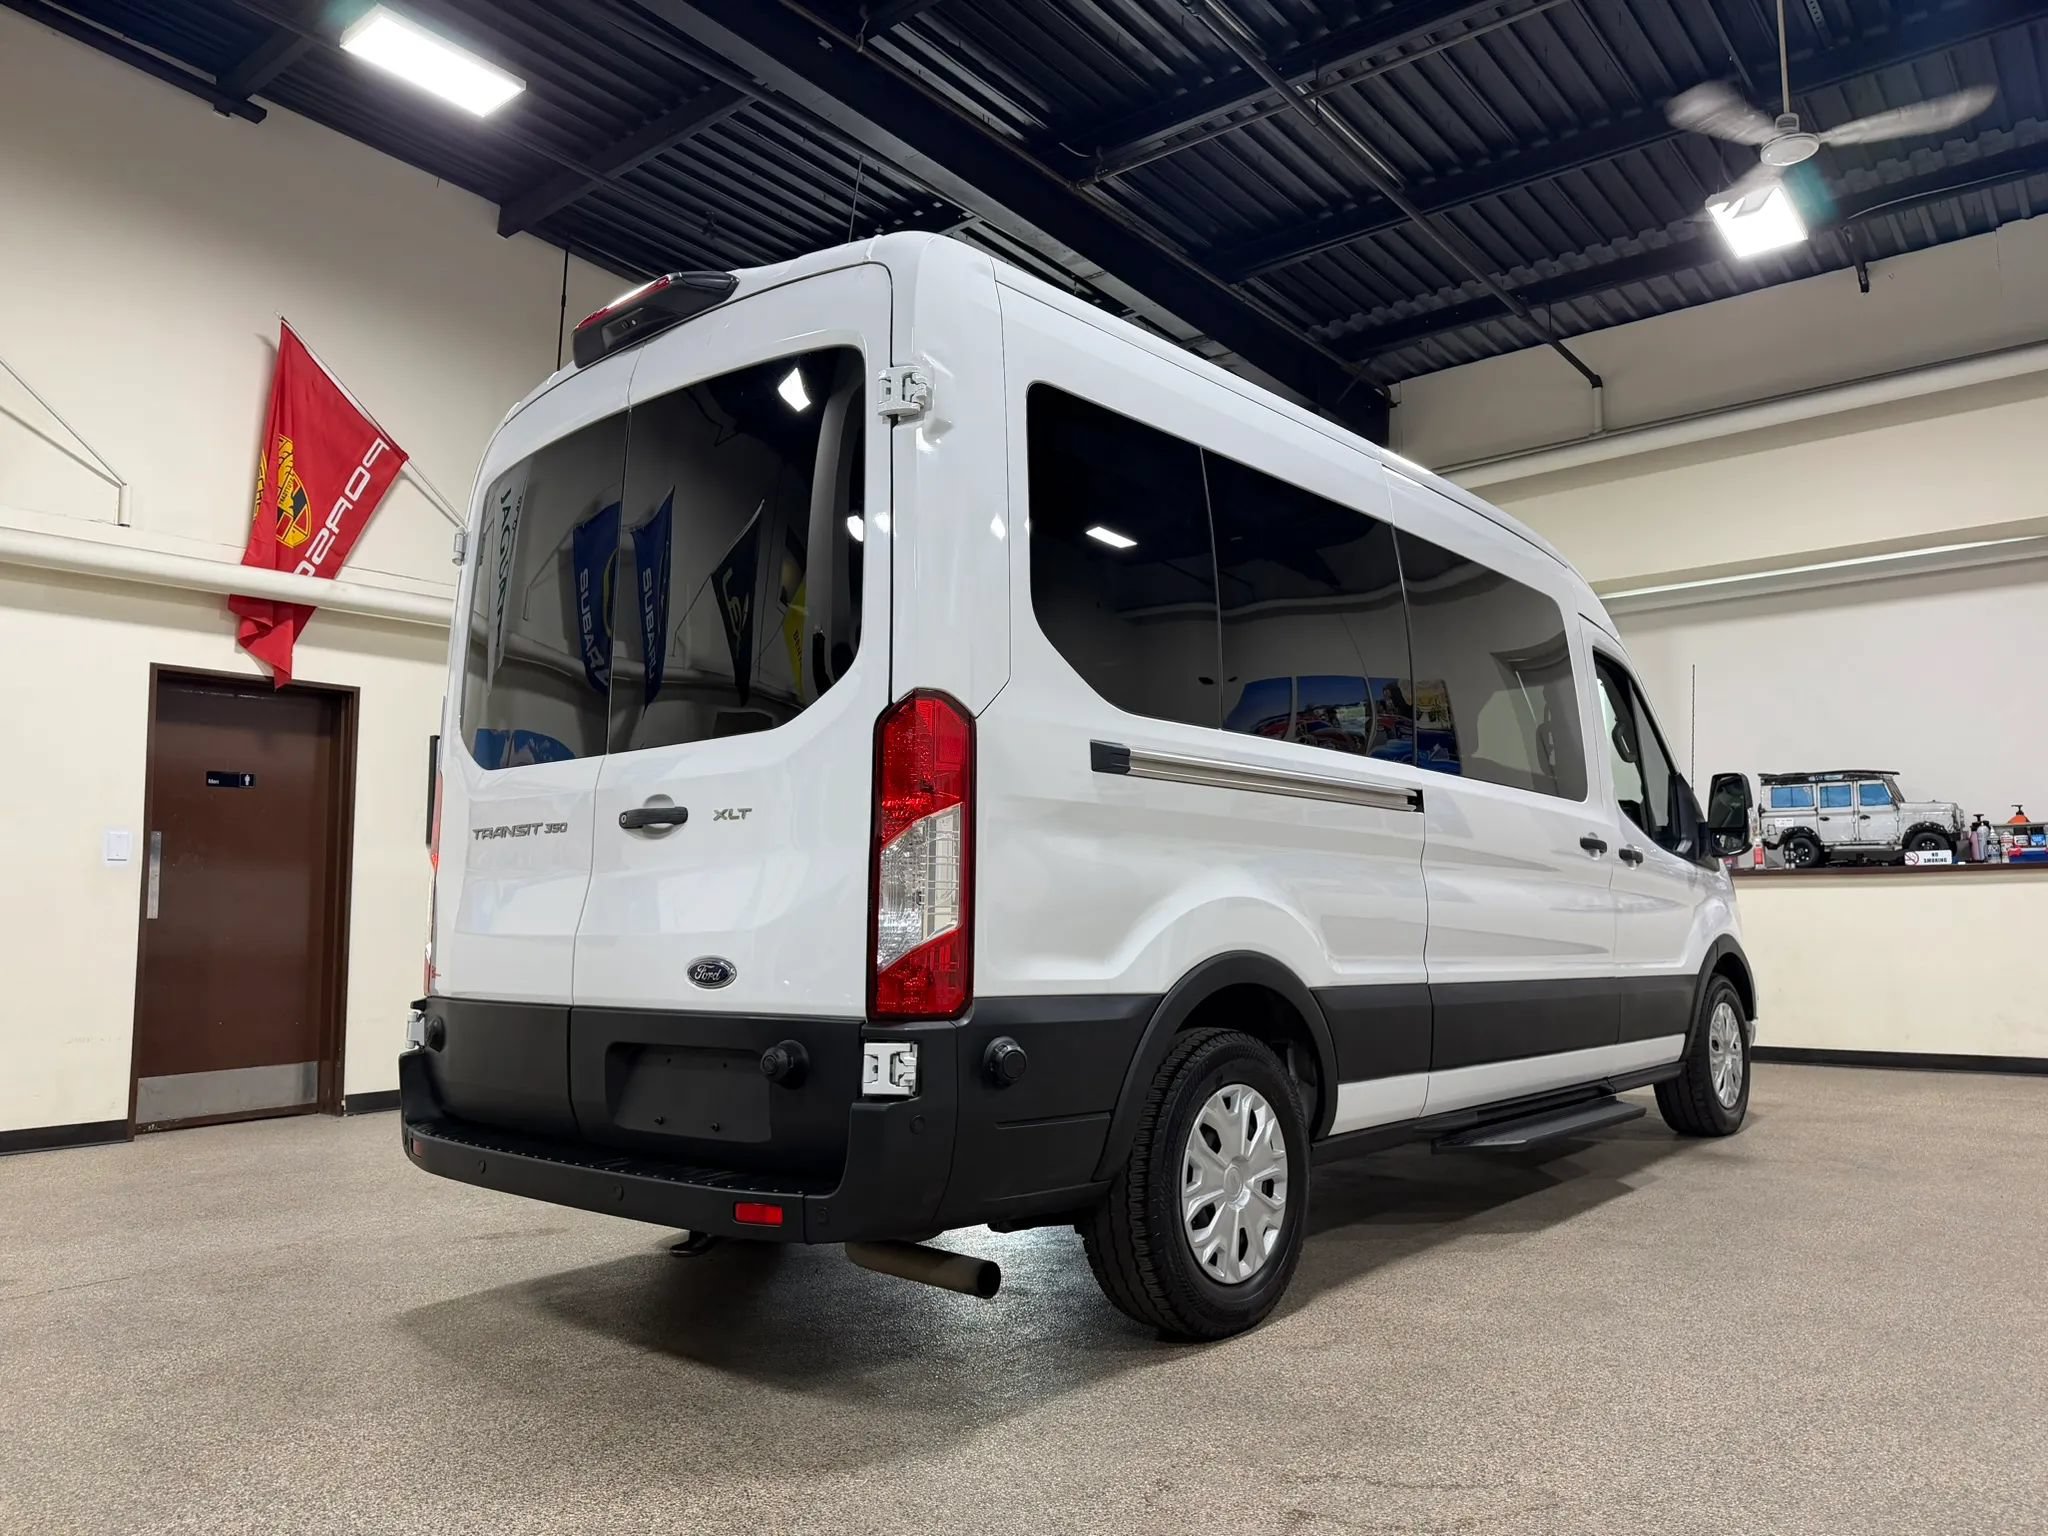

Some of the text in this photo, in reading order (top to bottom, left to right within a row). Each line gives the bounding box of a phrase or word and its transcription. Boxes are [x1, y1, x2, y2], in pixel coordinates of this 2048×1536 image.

[642, 567, 657, 680] SUBARU
[713, 808, 752, 821] XLT
[472, 822, 568, 840] TRANSIT 350
[694, 964, 722, 981] Ford
